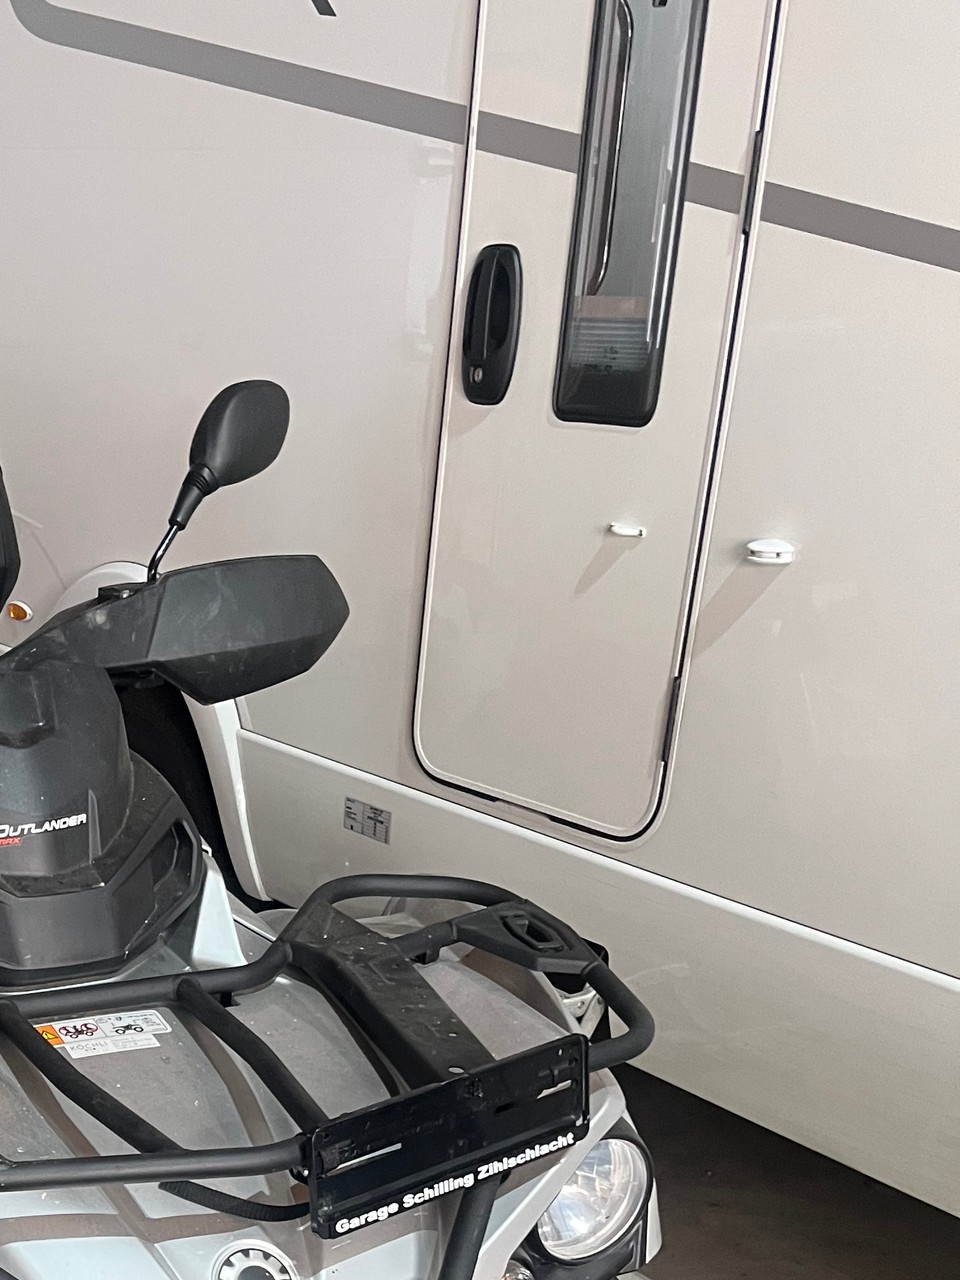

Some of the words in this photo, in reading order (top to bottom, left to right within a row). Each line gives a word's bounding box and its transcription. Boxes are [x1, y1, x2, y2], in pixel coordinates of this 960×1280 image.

[334, 1201, 399, 1235] Garage
[402, 1171, 475, 1209] Schilling
[477, 1131, 575, 1179] Zihlschlacht
